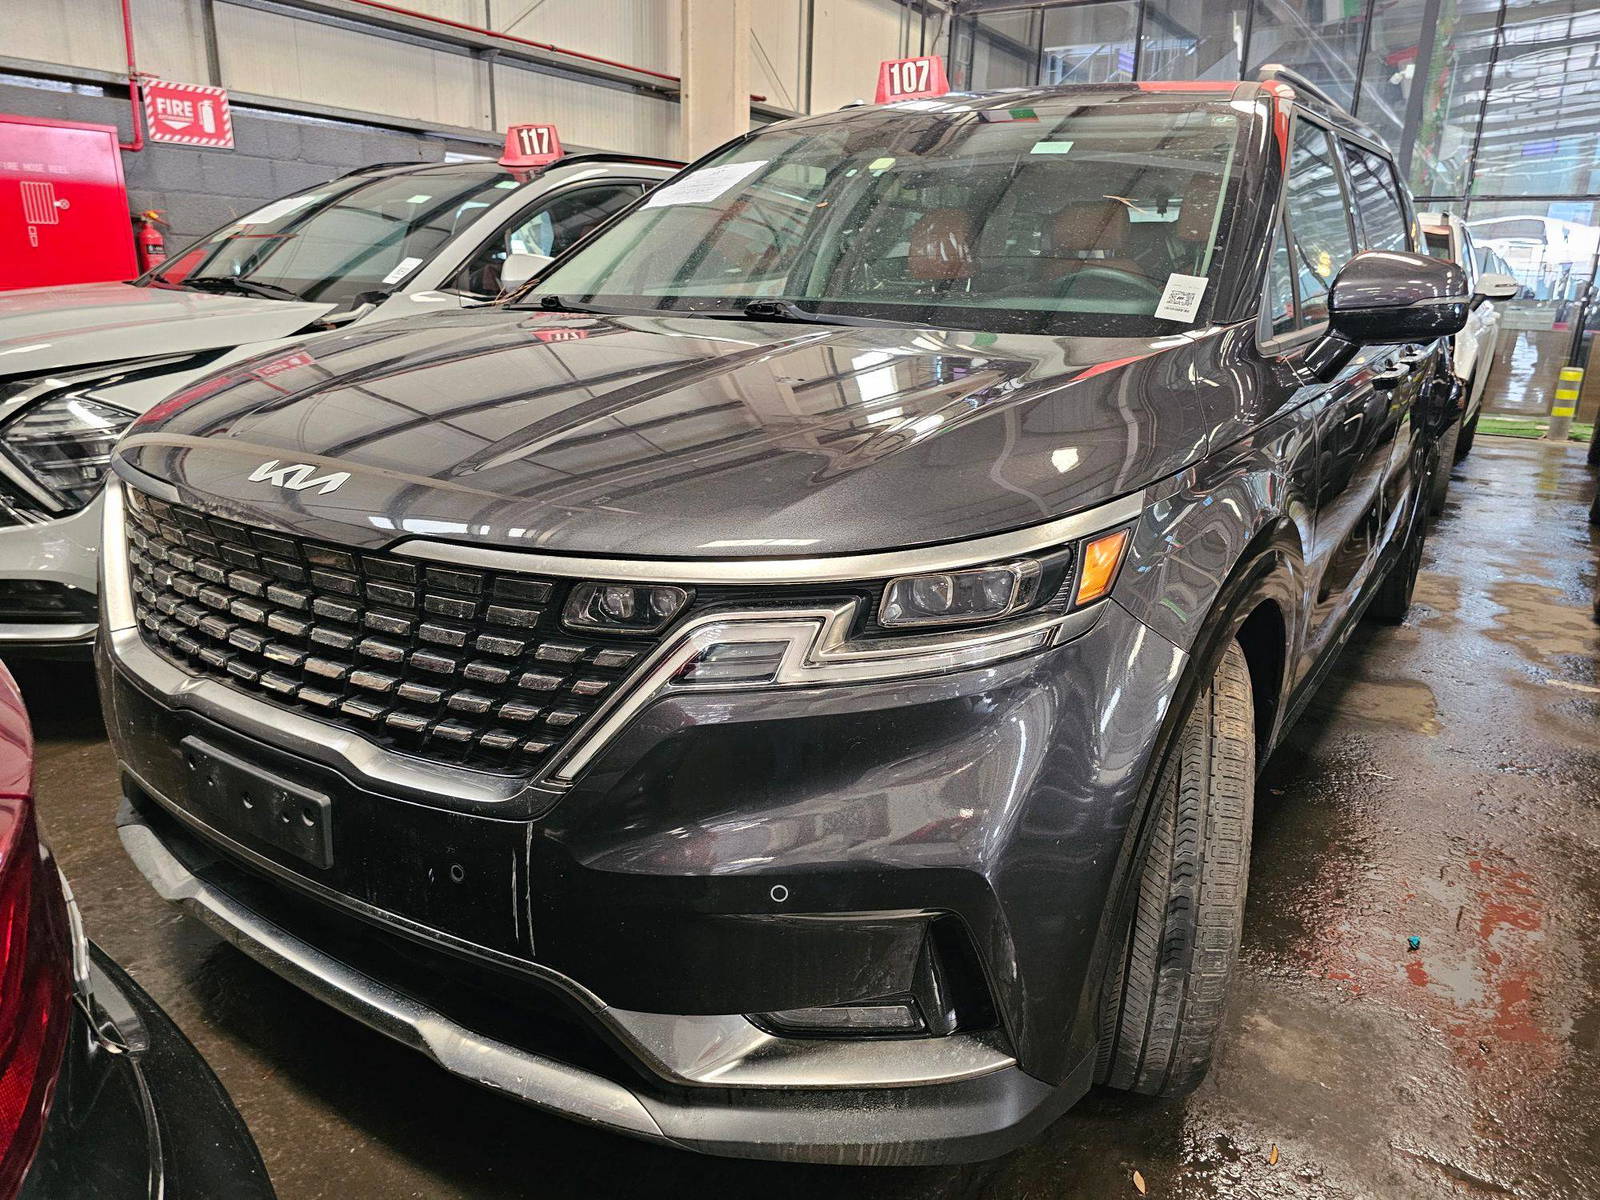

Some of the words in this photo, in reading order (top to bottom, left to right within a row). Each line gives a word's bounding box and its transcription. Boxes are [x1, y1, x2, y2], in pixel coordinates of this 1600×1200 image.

[890, 60, 930, 95] 107
[156, 97, 194, 117] FIRE
[520, 128, 549, 155] 117
[248, 459, 351, 496] KIA
